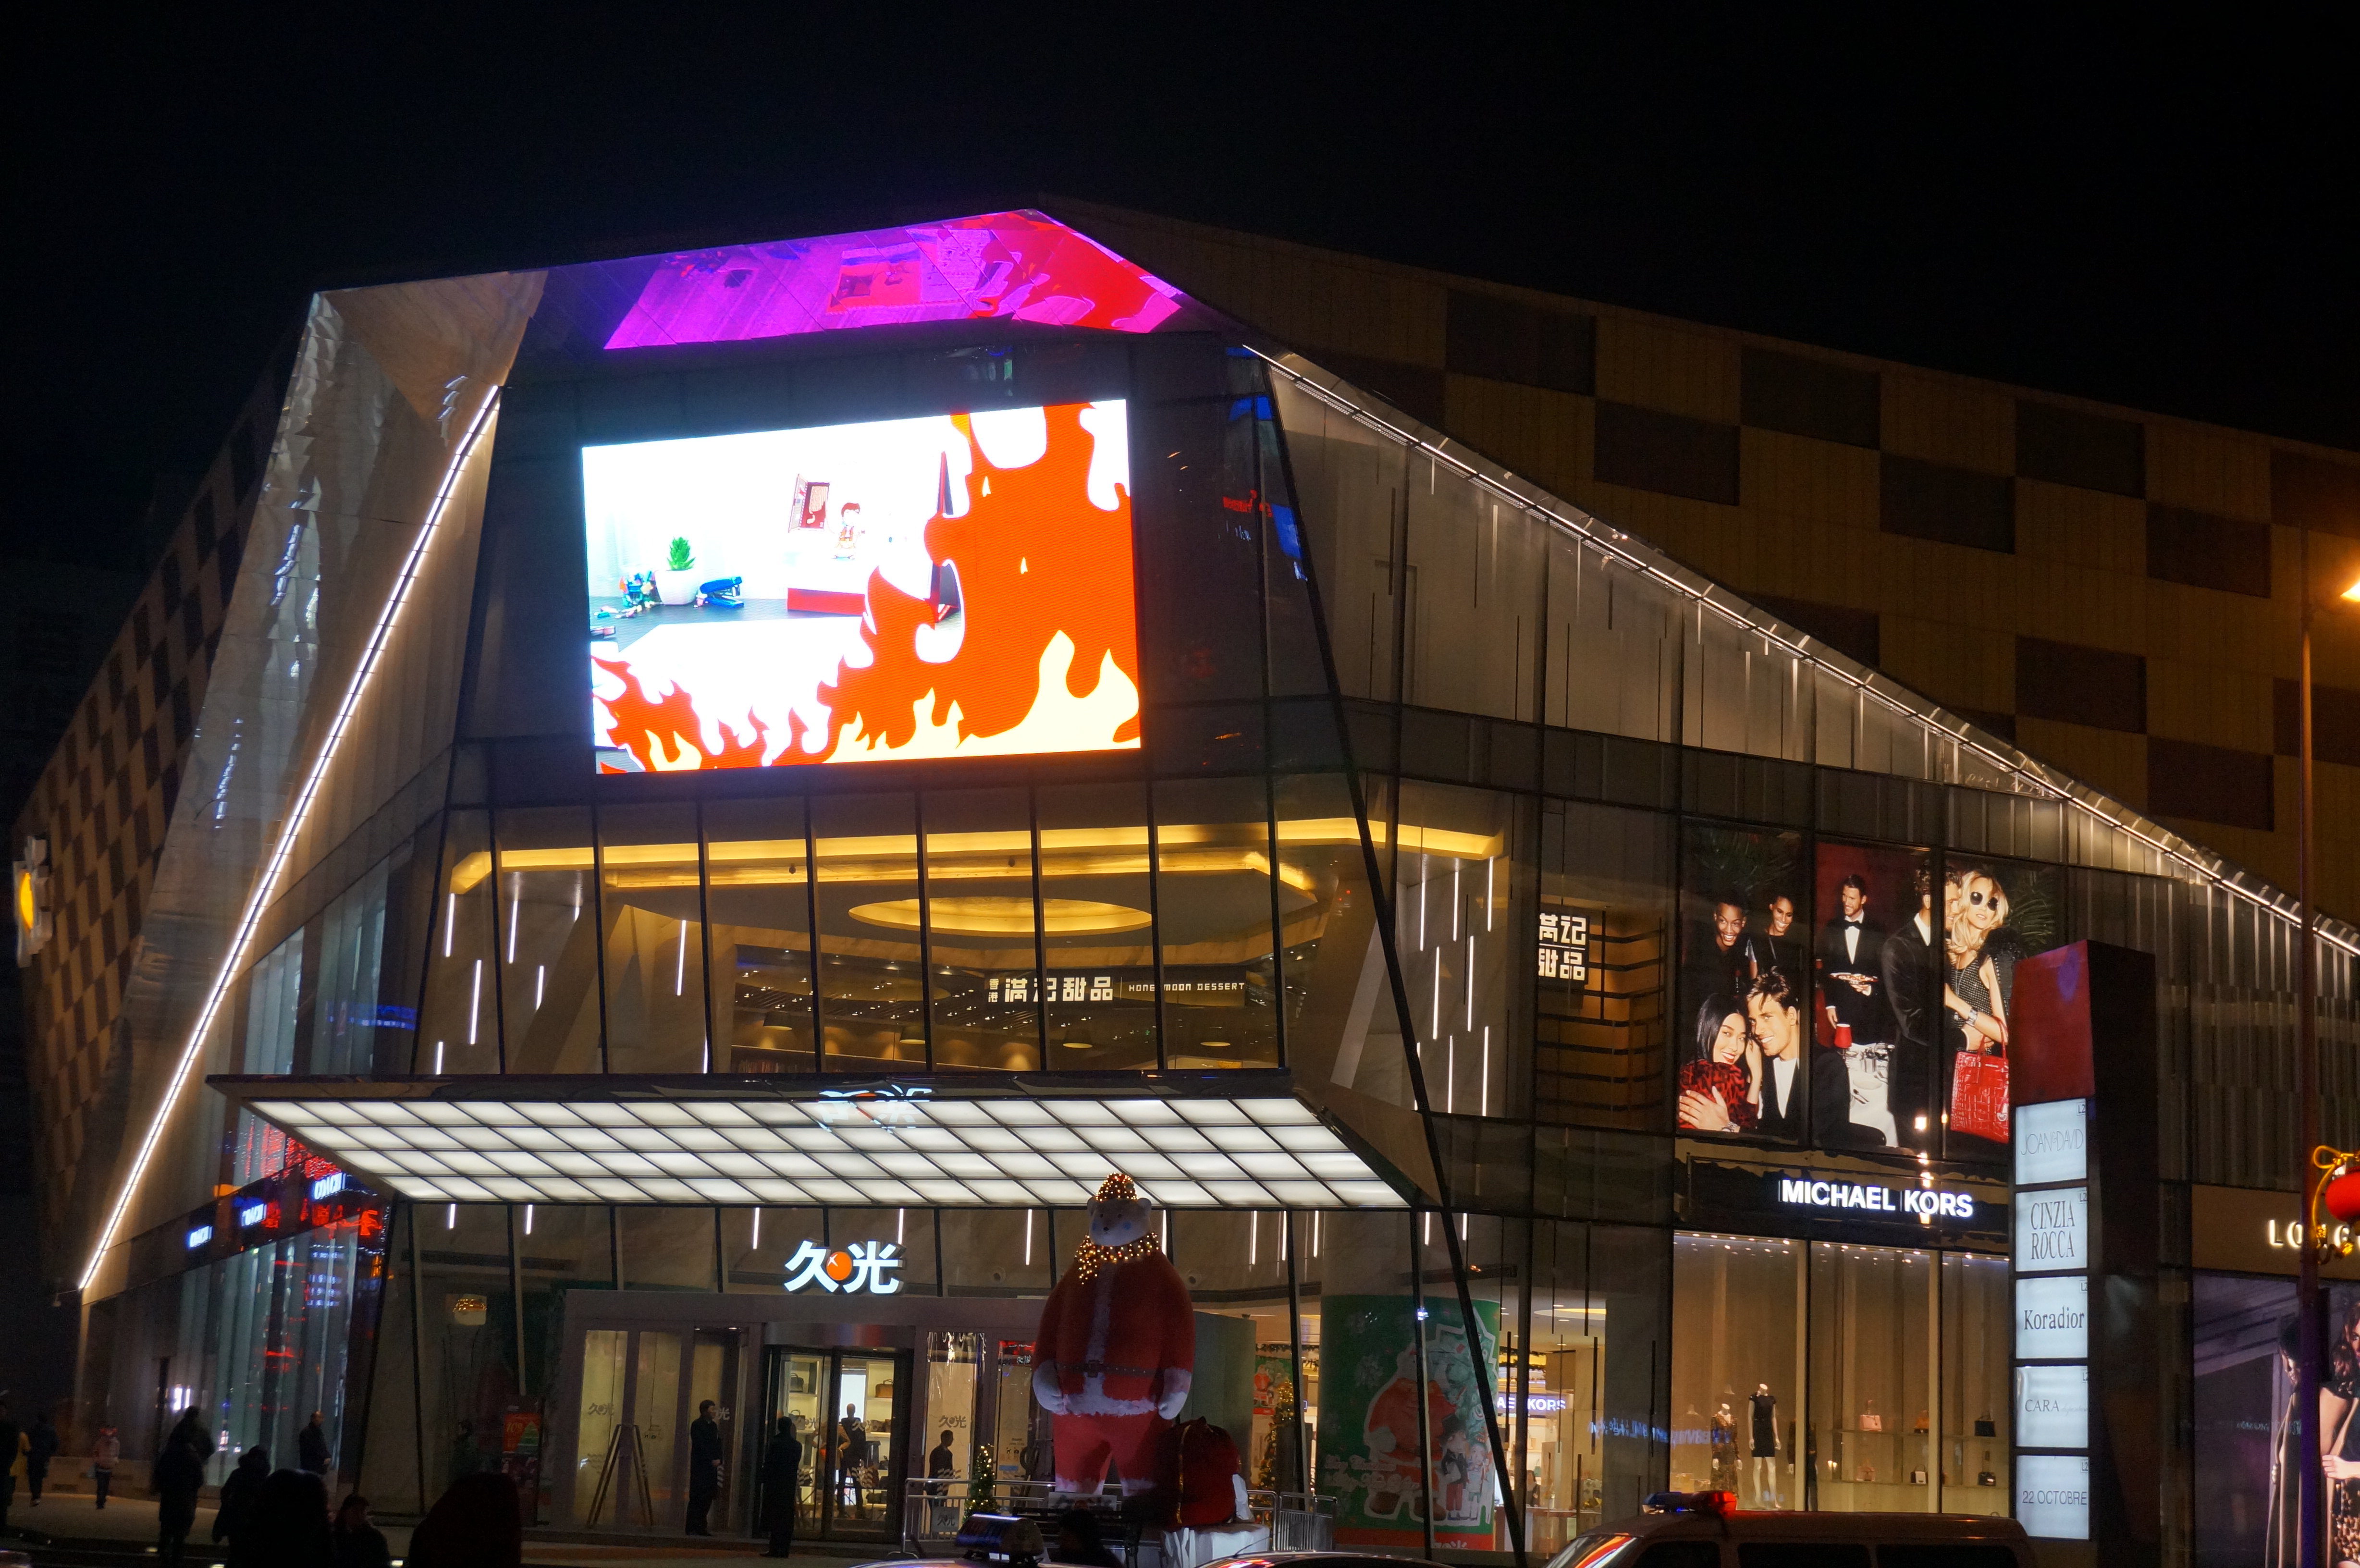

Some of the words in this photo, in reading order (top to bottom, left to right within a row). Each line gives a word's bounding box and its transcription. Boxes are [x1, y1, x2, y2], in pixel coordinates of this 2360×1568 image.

[1538, 948, 1585, 980] 甜品
[988, 979, 999, 1002] 香港
[2021, 1128, 2083, 1155] JOAN&DAVID
[1782, 1178, 1895, 1211] MICHAEL
[1905, 1189, 1973, 1217] KORS
[2030, 1200, 2075, 1230] CINZIA
[2031, 1230, 2075, 1260] ROCCA
[784, 1240, 903, 1294] 久光
[2024, 1305, 2084, 1330] Koradior
[588, 1402, 614, 1416] 久光
[1527, 1398, 1566, 1410] KORS
[2025, 1399, 2060, 1412] CARA
[938, 1415, 967, 1429] 久光
[2023, 1491, 2034, 1504] 22
[2037, 1490, 2088, 1505] OCTOBRE
[937, 1514, 956, 1526] 久光
